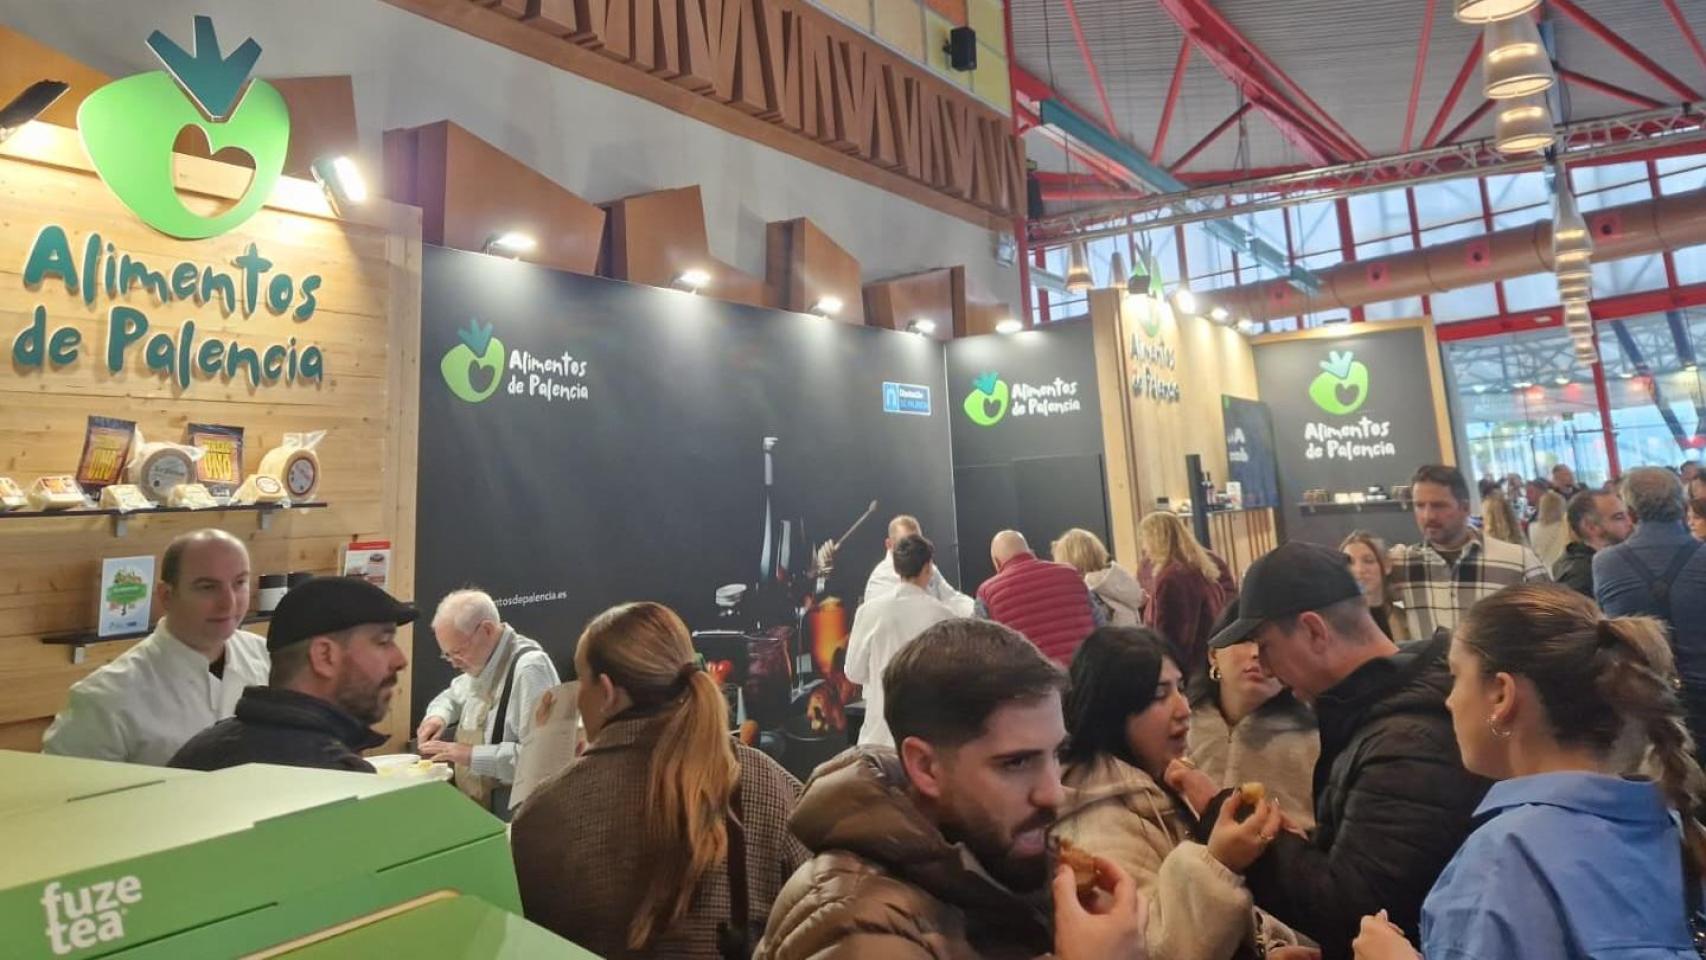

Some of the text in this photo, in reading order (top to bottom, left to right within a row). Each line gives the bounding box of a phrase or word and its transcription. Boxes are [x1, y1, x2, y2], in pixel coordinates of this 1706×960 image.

[23, 225, 322, 322] Alimentos
[12, 304, 324, 390] de Palencia
[509, 349, 587, 377] Alimentos
[507, 374, 588, 401] de Palencia
[1011, 376, 1078, 401] Alimentos
[1011, 398, 1080, 417] de Palencia
[1304, 416, 1390, 442] Alimentos
[1305, 440, 1395, 461] de Palencia
[41, 875, 142, 921] fuze
[45, 909, 124, 955] tea
